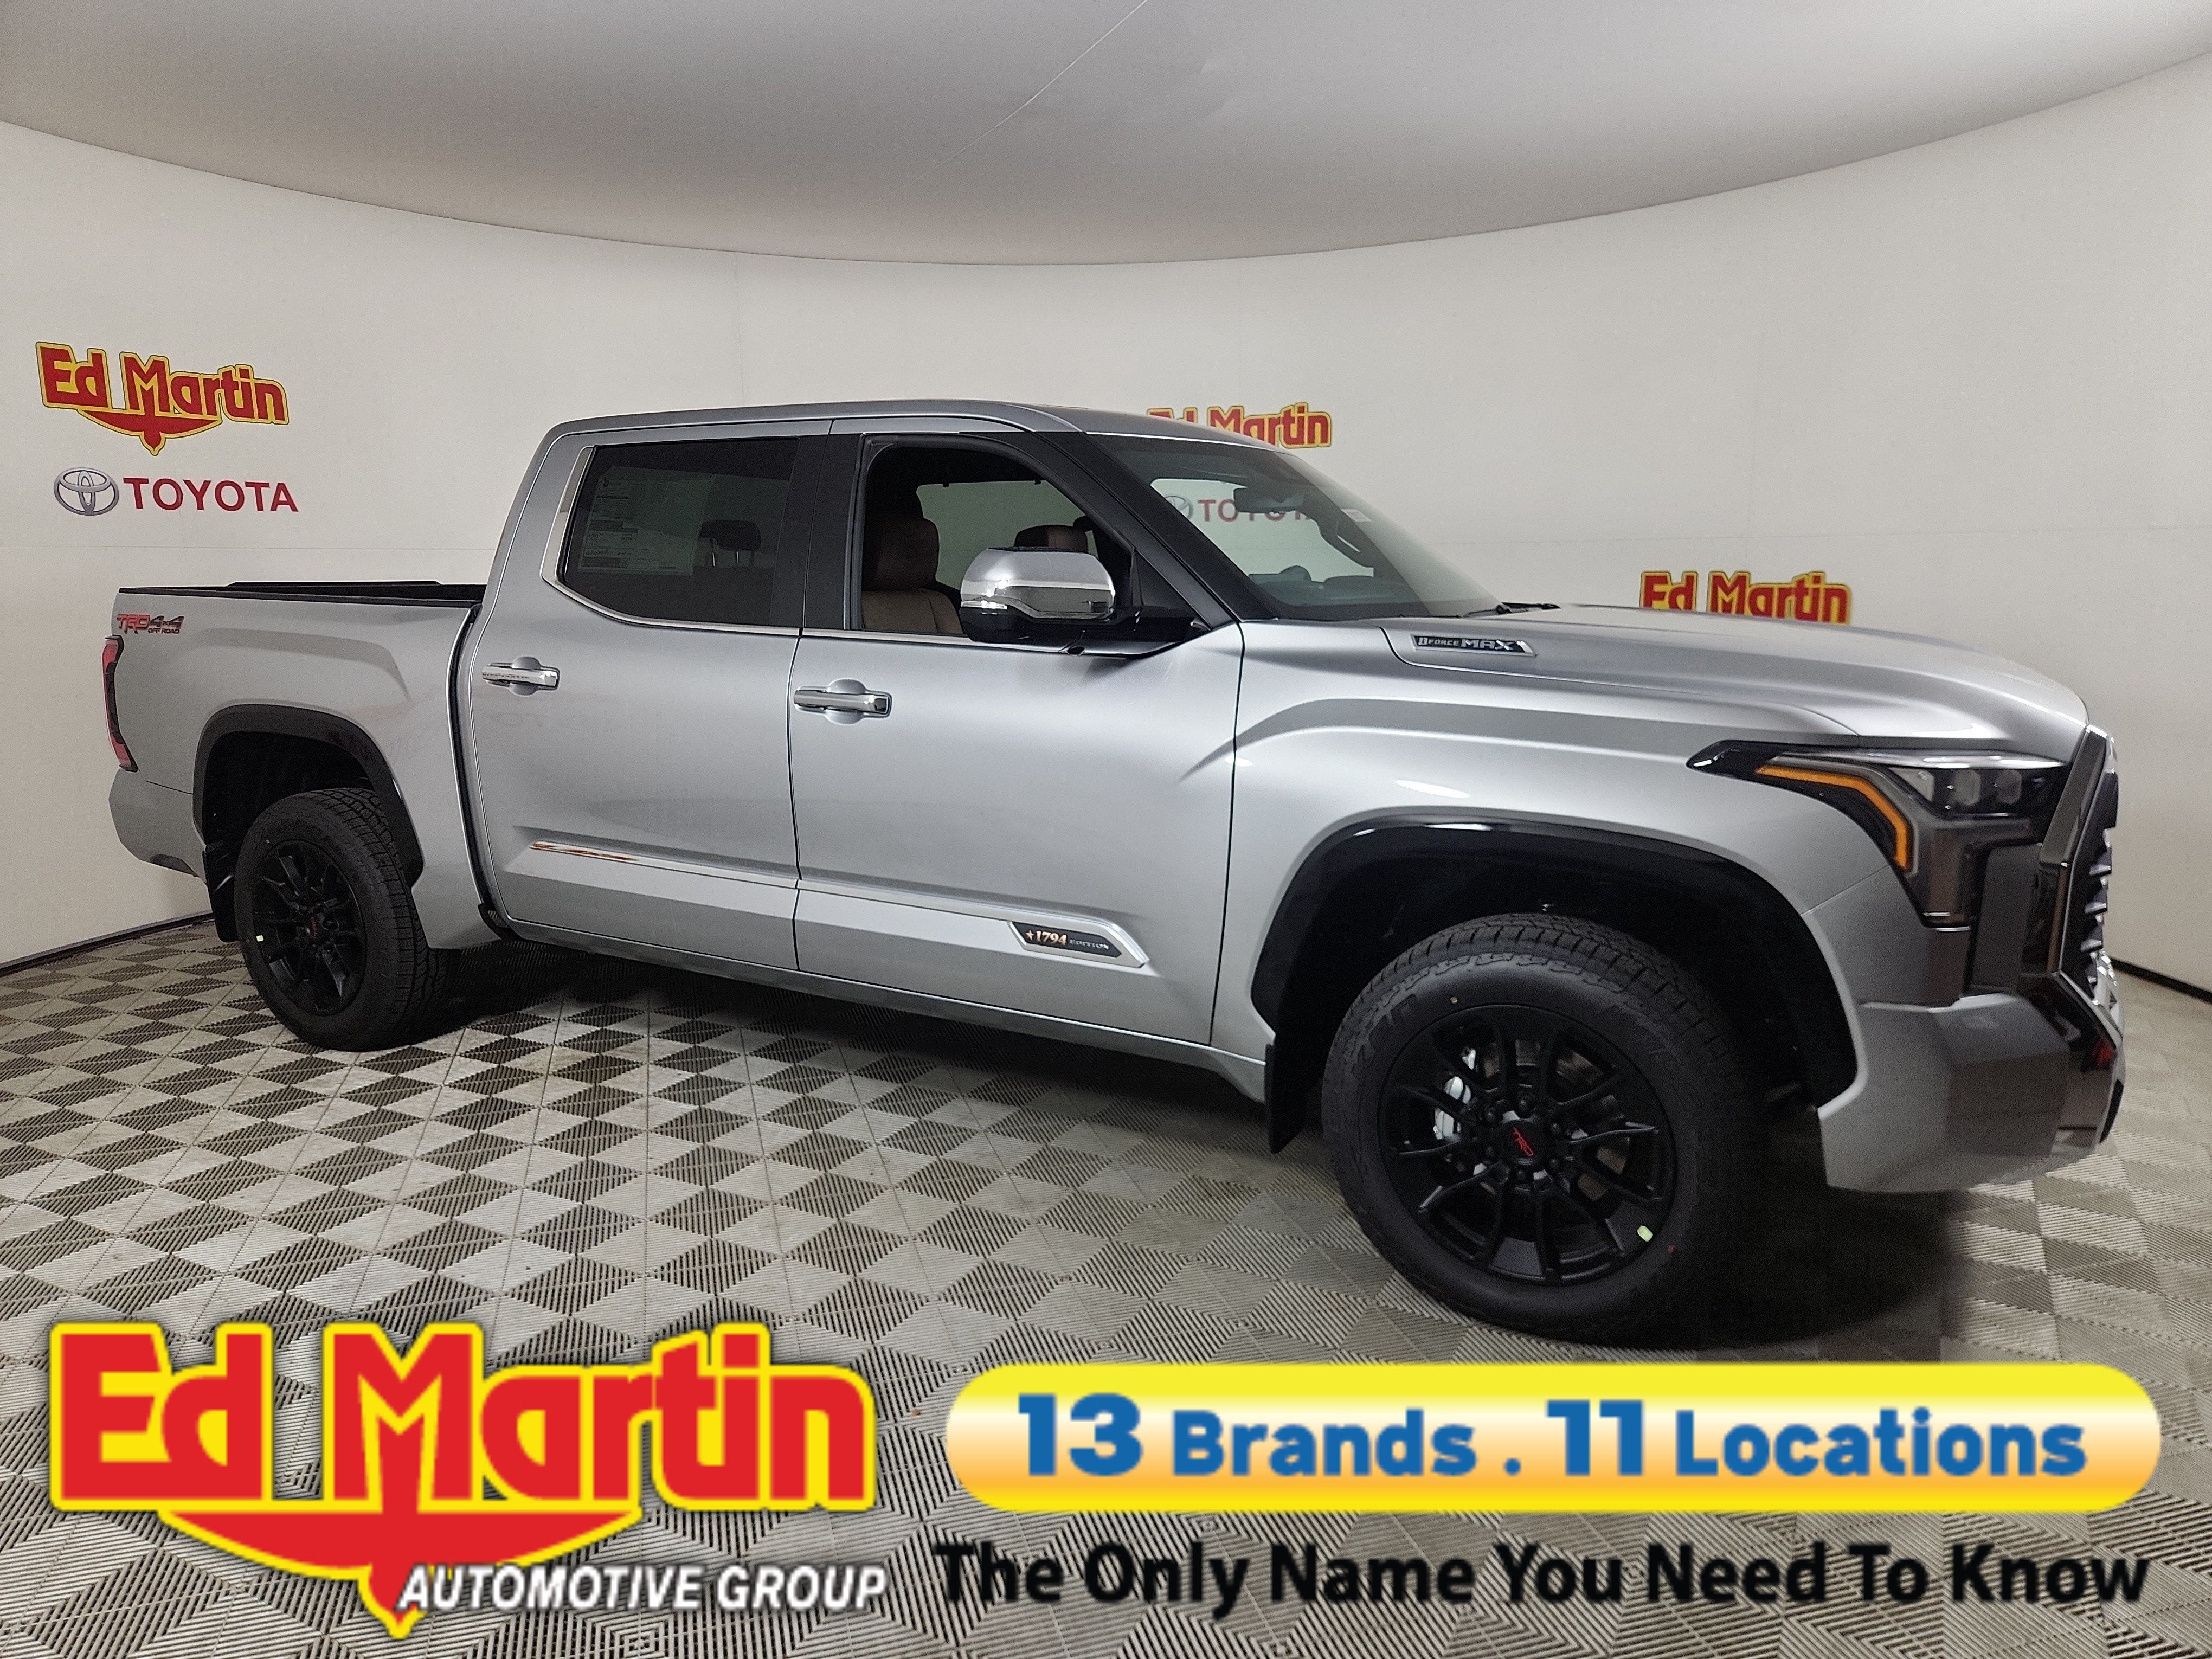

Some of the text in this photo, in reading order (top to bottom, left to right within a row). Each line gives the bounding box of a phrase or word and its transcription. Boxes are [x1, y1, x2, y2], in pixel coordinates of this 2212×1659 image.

[36, 342, 289, 425] Ed Martin
[123, 477, 299, 512] TOYOTA
[1707, 571, 1851, 625] Martin
[117, 614, 150, 634] TRD
[1461, 638, 1514, 651] MAX
[1035, 930, 1068, 946] 1794
